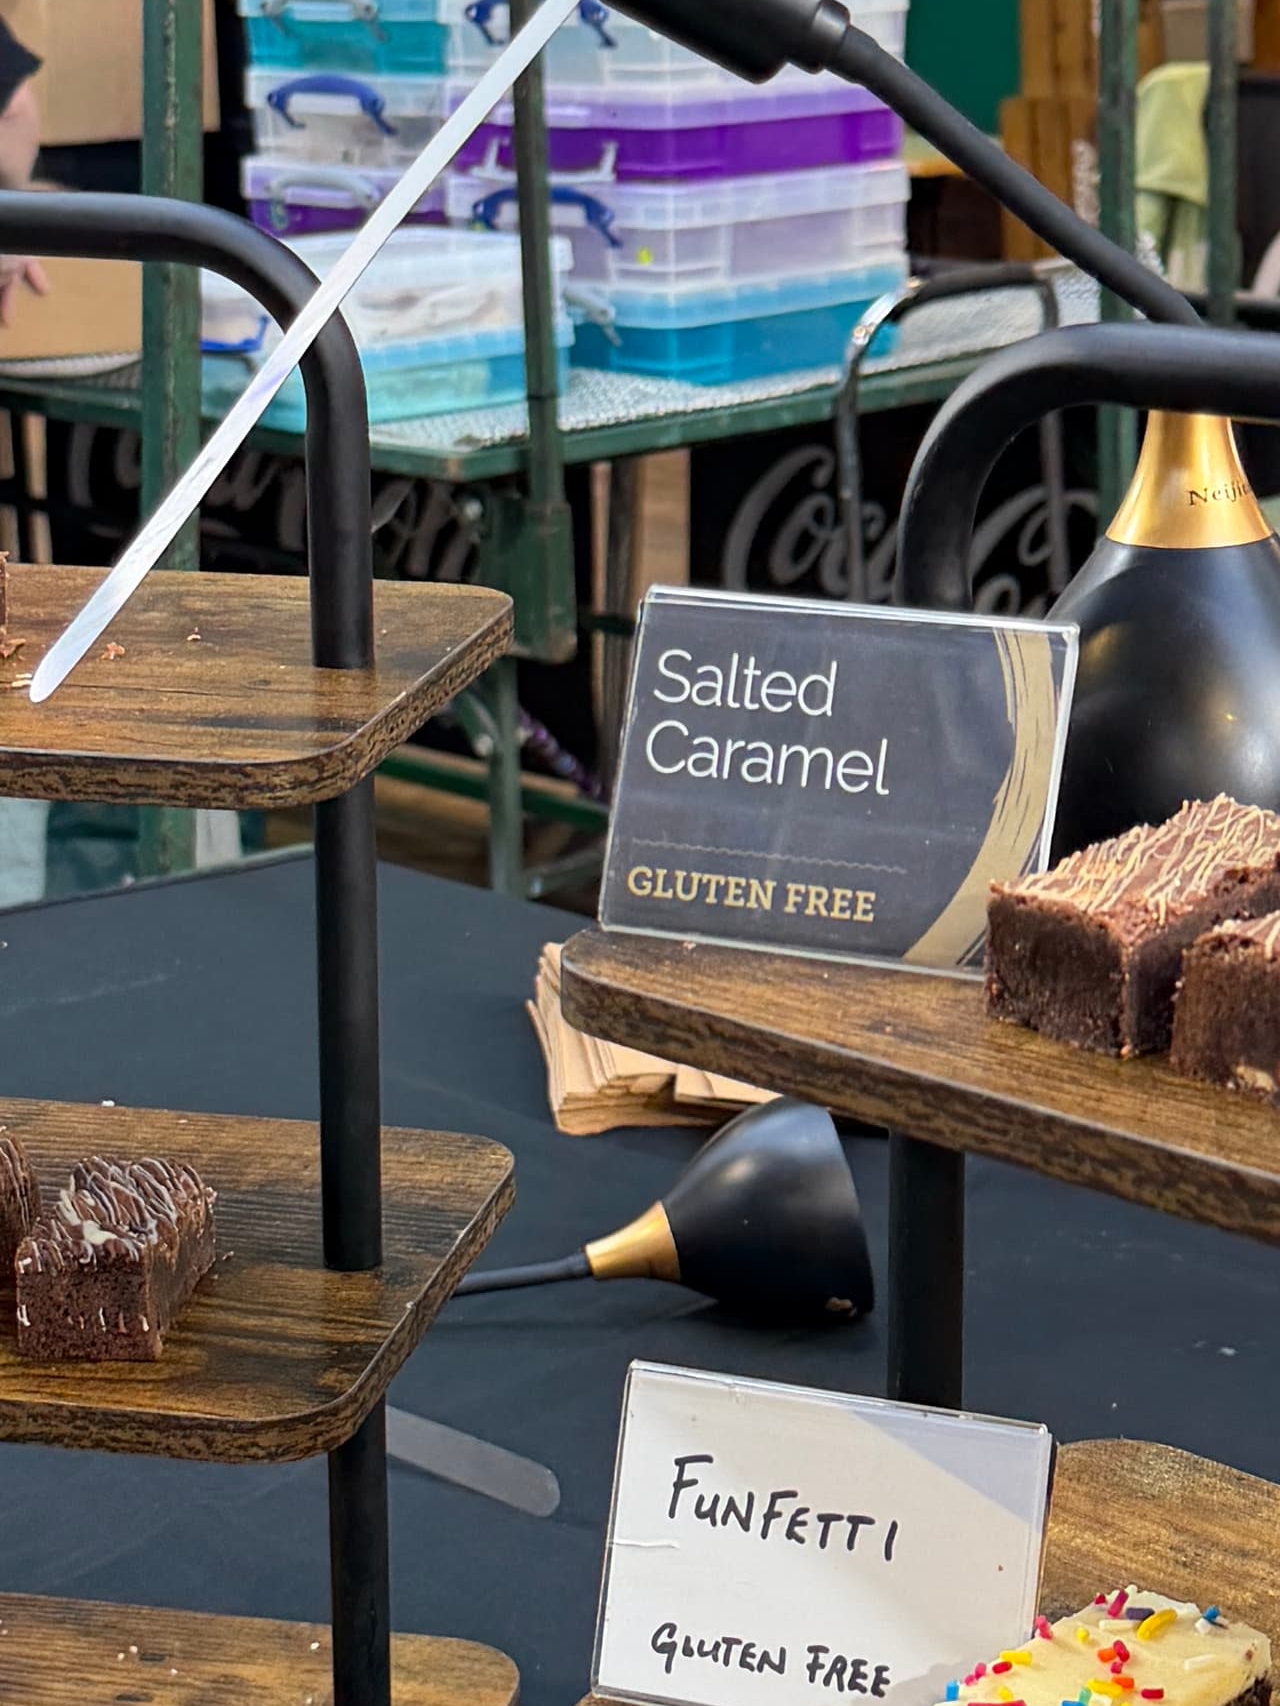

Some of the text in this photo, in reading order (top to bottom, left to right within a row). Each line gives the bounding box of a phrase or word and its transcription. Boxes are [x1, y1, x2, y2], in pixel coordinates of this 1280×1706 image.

[653, 649, 838, 717] Salted
[646, 720, 890, 796] Caramel
[627, 866, 876, 923] GLUTEN FREE
[668, 1454, 899, 1561] FUNFETTI
[651, 1622, 891, 1698] GLUTEN FREE
